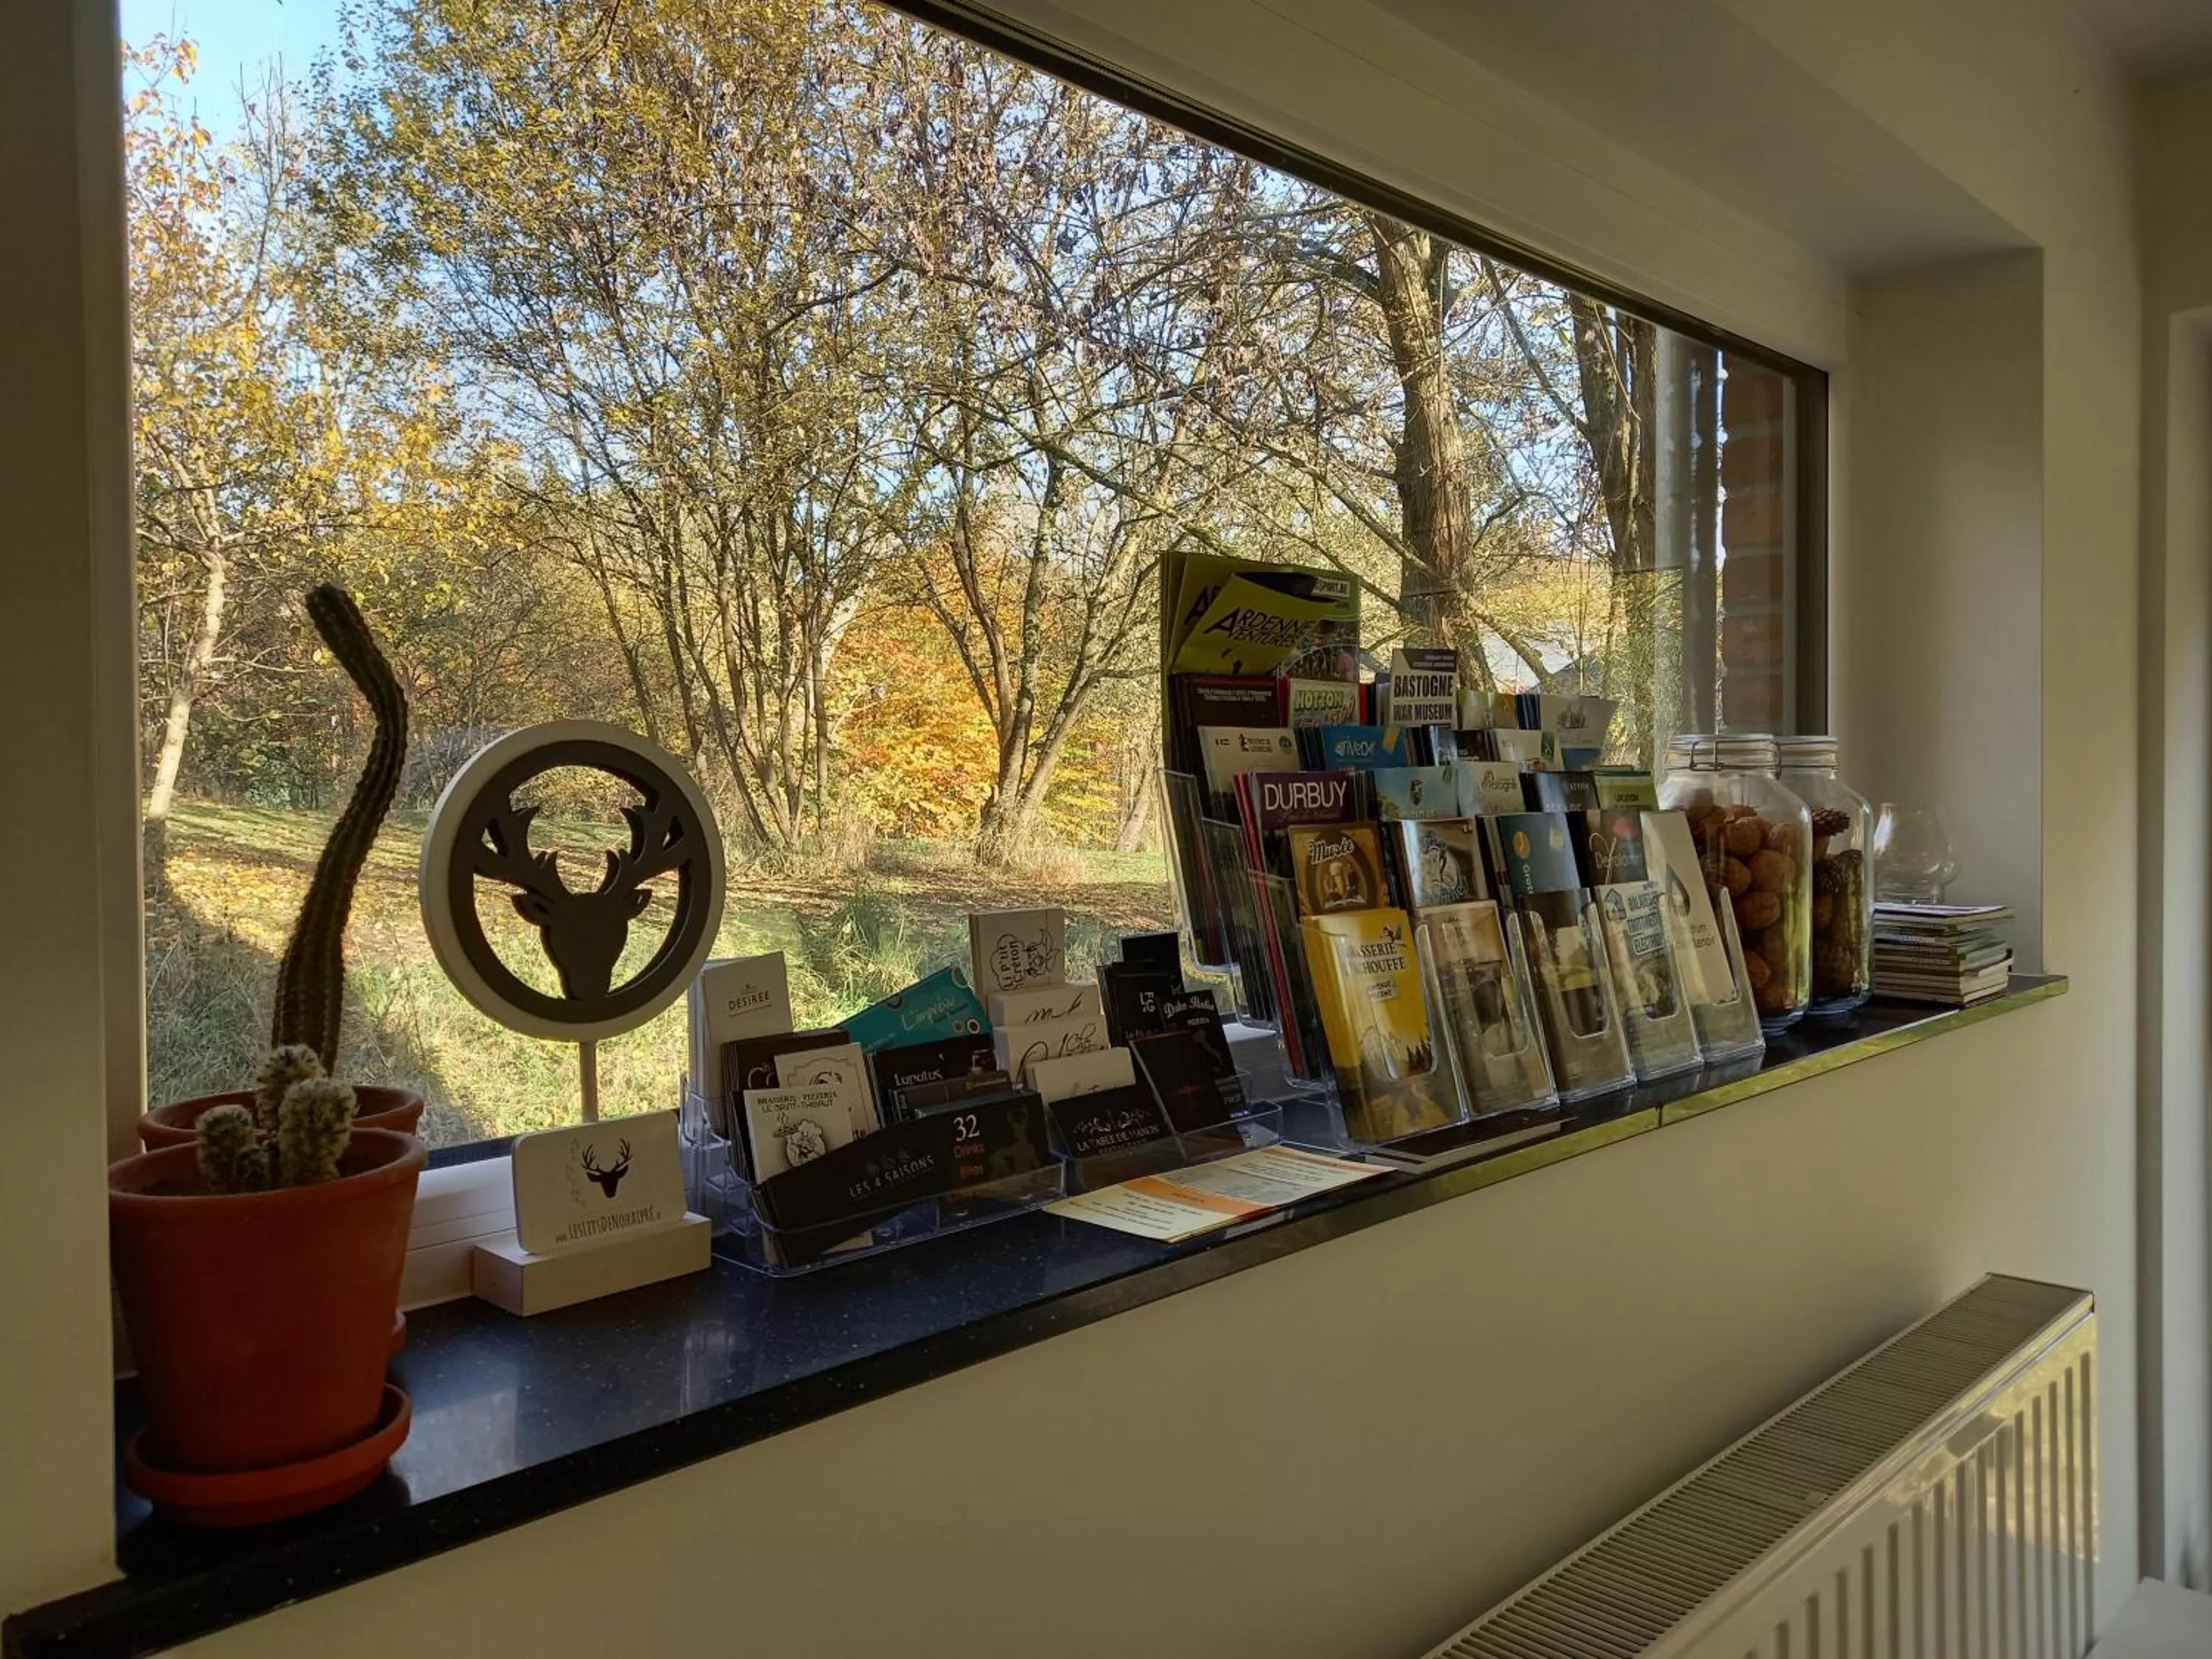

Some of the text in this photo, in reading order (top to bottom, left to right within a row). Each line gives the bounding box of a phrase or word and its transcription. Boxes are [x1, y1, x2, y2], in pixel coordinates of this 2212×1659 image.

[1394, 675, 1453, 697] BASTOGNE
[1295, 689, 1343, 712] HOTTON
[1394, 703, 1452, 721] WAR MUSEUM
[1263, 782, 1346, 810] DURBUY
[1308, 836, 1354, 865] Musée
[953, 1114, 980, 1142] 32
[849, 1183, 872, 1199] LES
[884, 1155, 936, 1181] SAISONS
